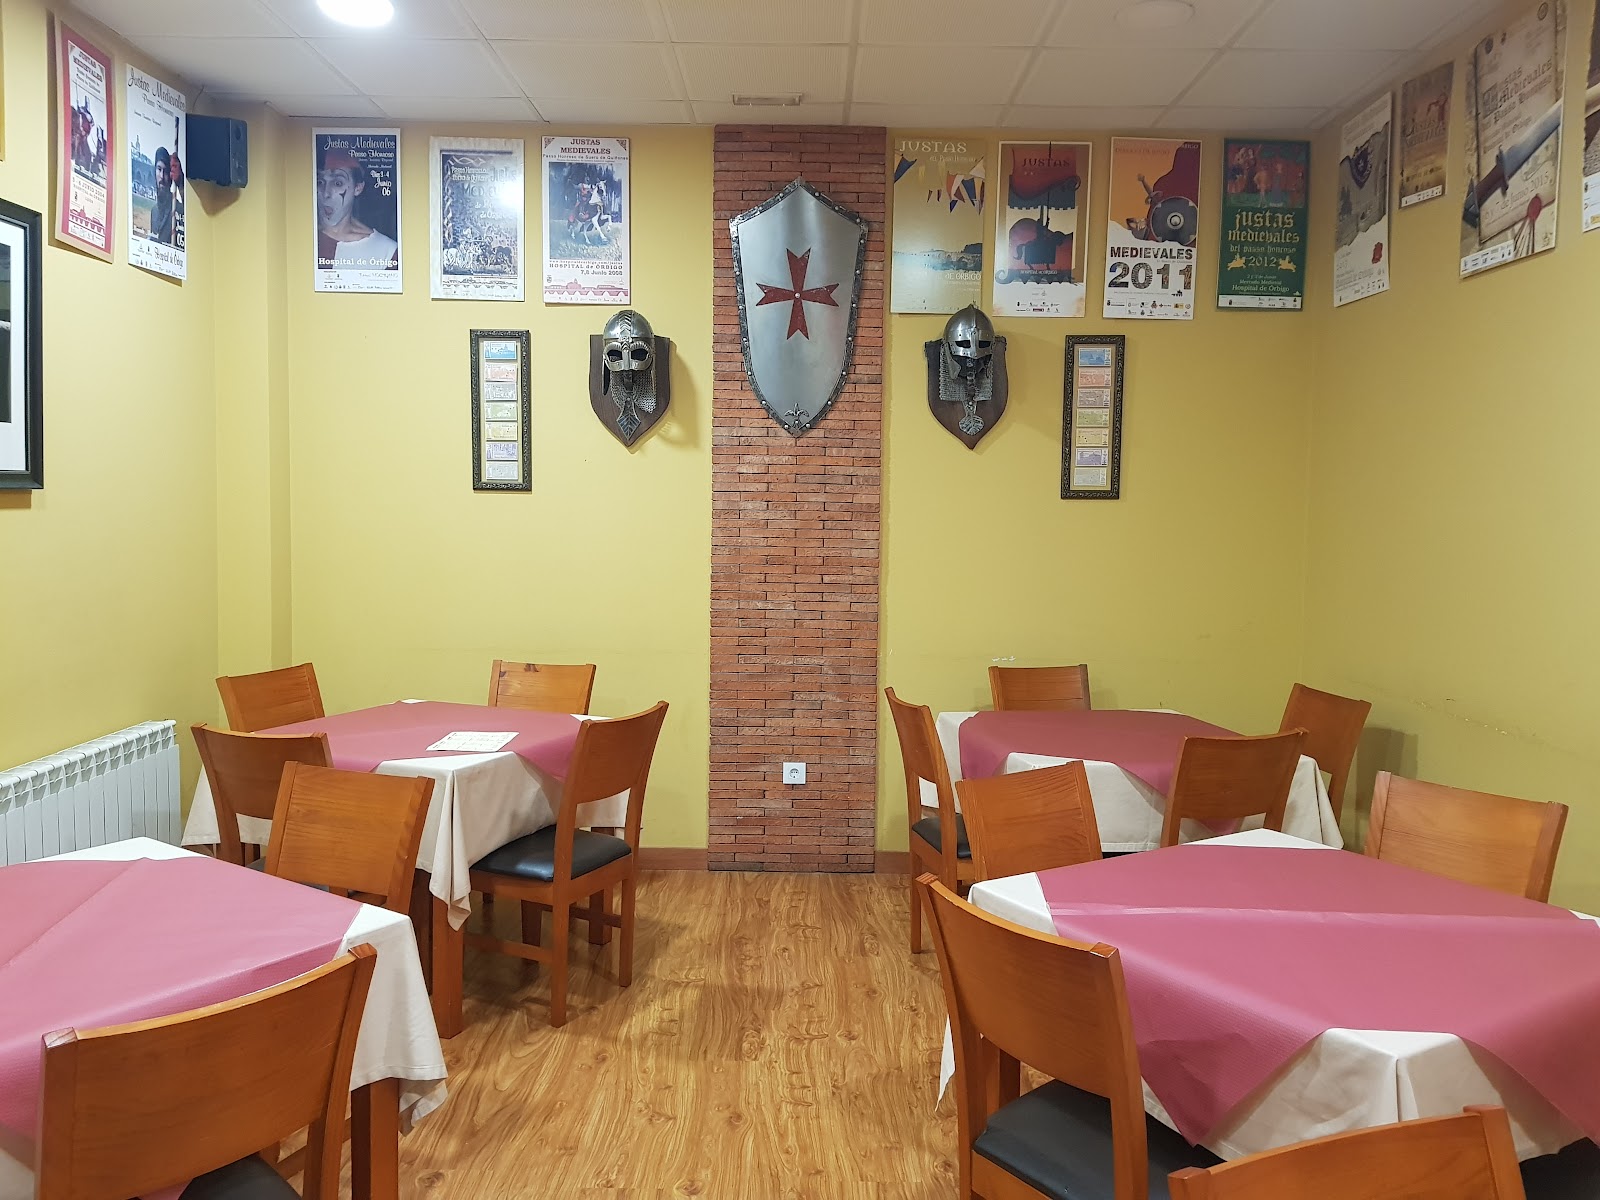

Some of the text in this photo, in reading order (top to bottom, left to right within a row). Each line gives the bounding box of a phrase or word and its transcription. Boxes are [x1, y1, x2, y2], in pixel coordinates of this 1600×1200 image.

[73, 55, 102, 82] MEDIEVALES
[128, 67, 149, 92] Justas
[152, 81, 185, 112] Medievales
[323, 136, 395, 150] Justas Medievales
[570, 138, 601, 146] JUSTAS
[899, 141, 967, 153] JUSTAS
[560, 147, 611, 155] MEDIEVALES
[1022, 158, 1071, 168] JUSTAS
[381, 187, 391, 196] 06
[1235, 209, 1295, 231] justas
[1228, 228, 1300, 243] medievales
[1110, 246, 1193, 260] MEDIEVALES
[1230, 244, 1241, 253] del
[318, 256, 398, 268] Hospital de Órbigo
[1248, 256, 1277, 267] 2012
[1108, 261, 1193, 290] 2011
[1231, 284, 1258, 292] Hospital
